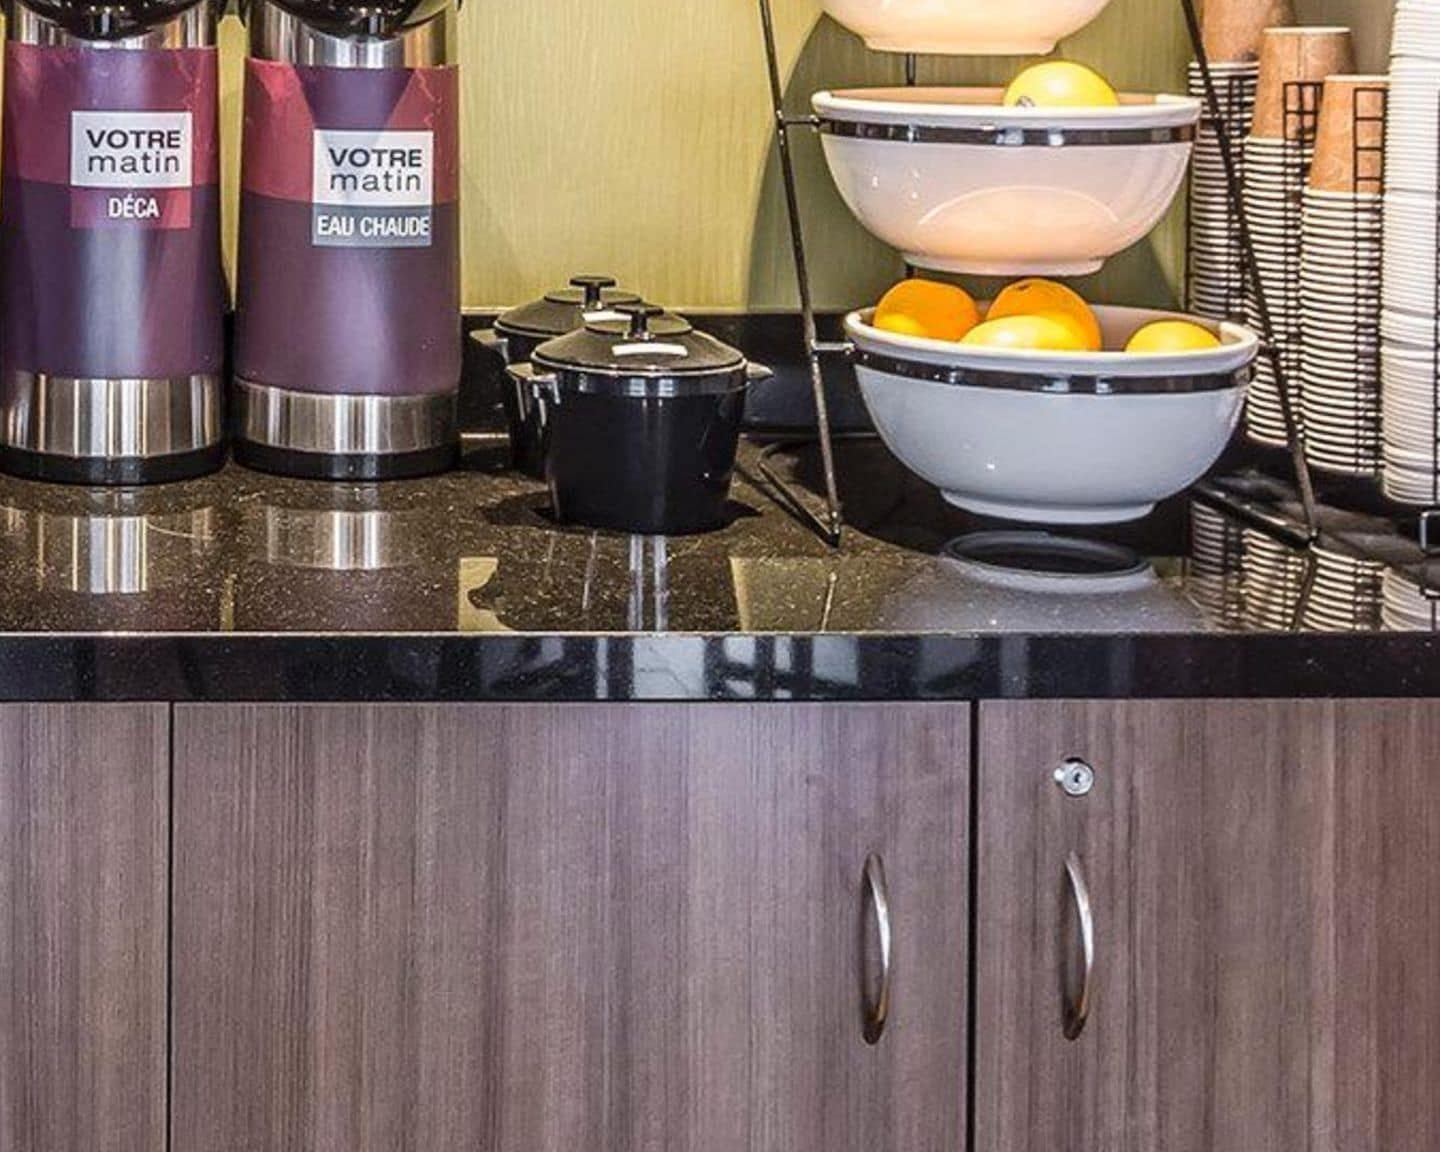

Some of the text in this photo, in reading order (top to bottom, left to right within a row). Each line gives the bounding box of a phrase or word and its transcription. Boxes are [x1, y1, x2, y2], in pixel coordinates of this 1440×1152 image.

[85, 129, 181, 149] VOTRE
[88, 151, 180, 174] matin
[328, 148, 423, 168] VOTRE
[330, 170, 421, 192] matin
[108, 193, 161, 218] DÉCA
[317, 215, 430, 237] EAU CHAUDE
